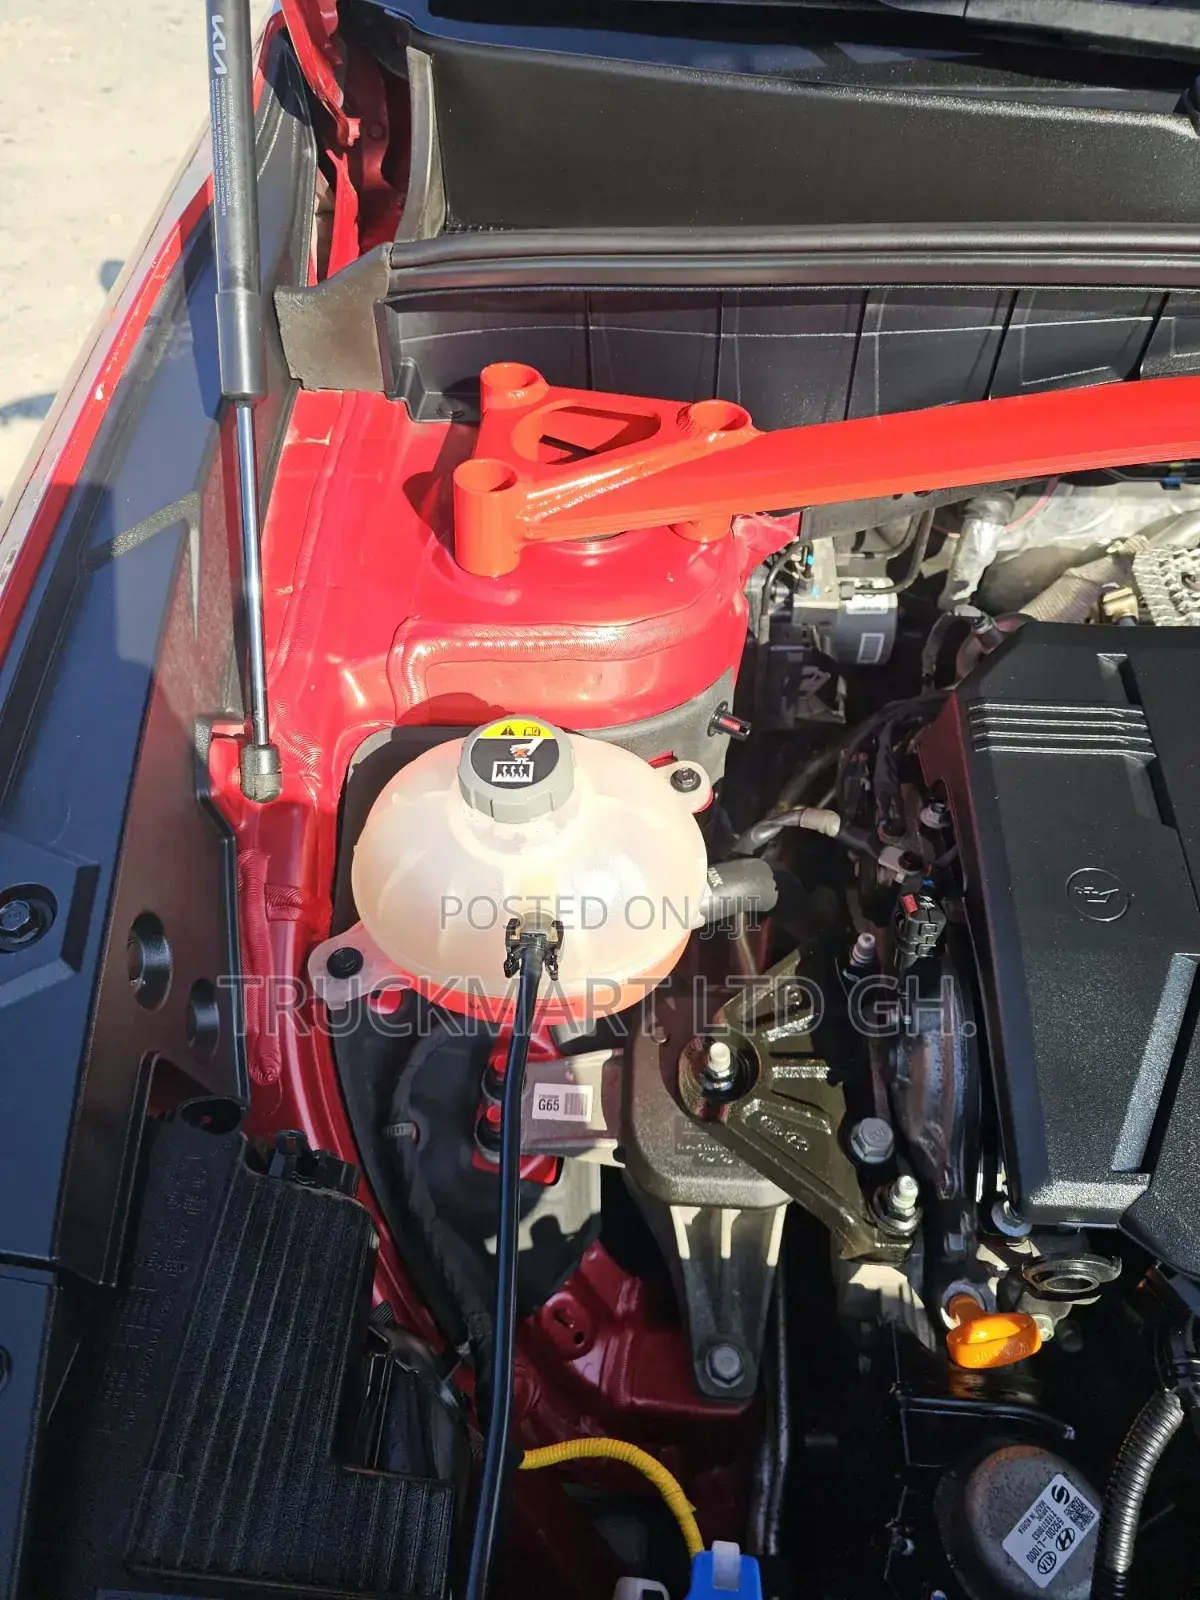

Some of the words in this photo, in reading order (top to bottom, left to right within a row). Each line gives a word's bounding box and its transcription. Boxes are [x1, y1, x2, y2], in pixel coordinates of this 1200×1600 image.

[211, 15, 227, 75] KIA
[538, 1098, 560, 1111] G65
[1018, 1518, 1032, 1534] KOREA
[1040, 1552, 1056, 1572] KIA
